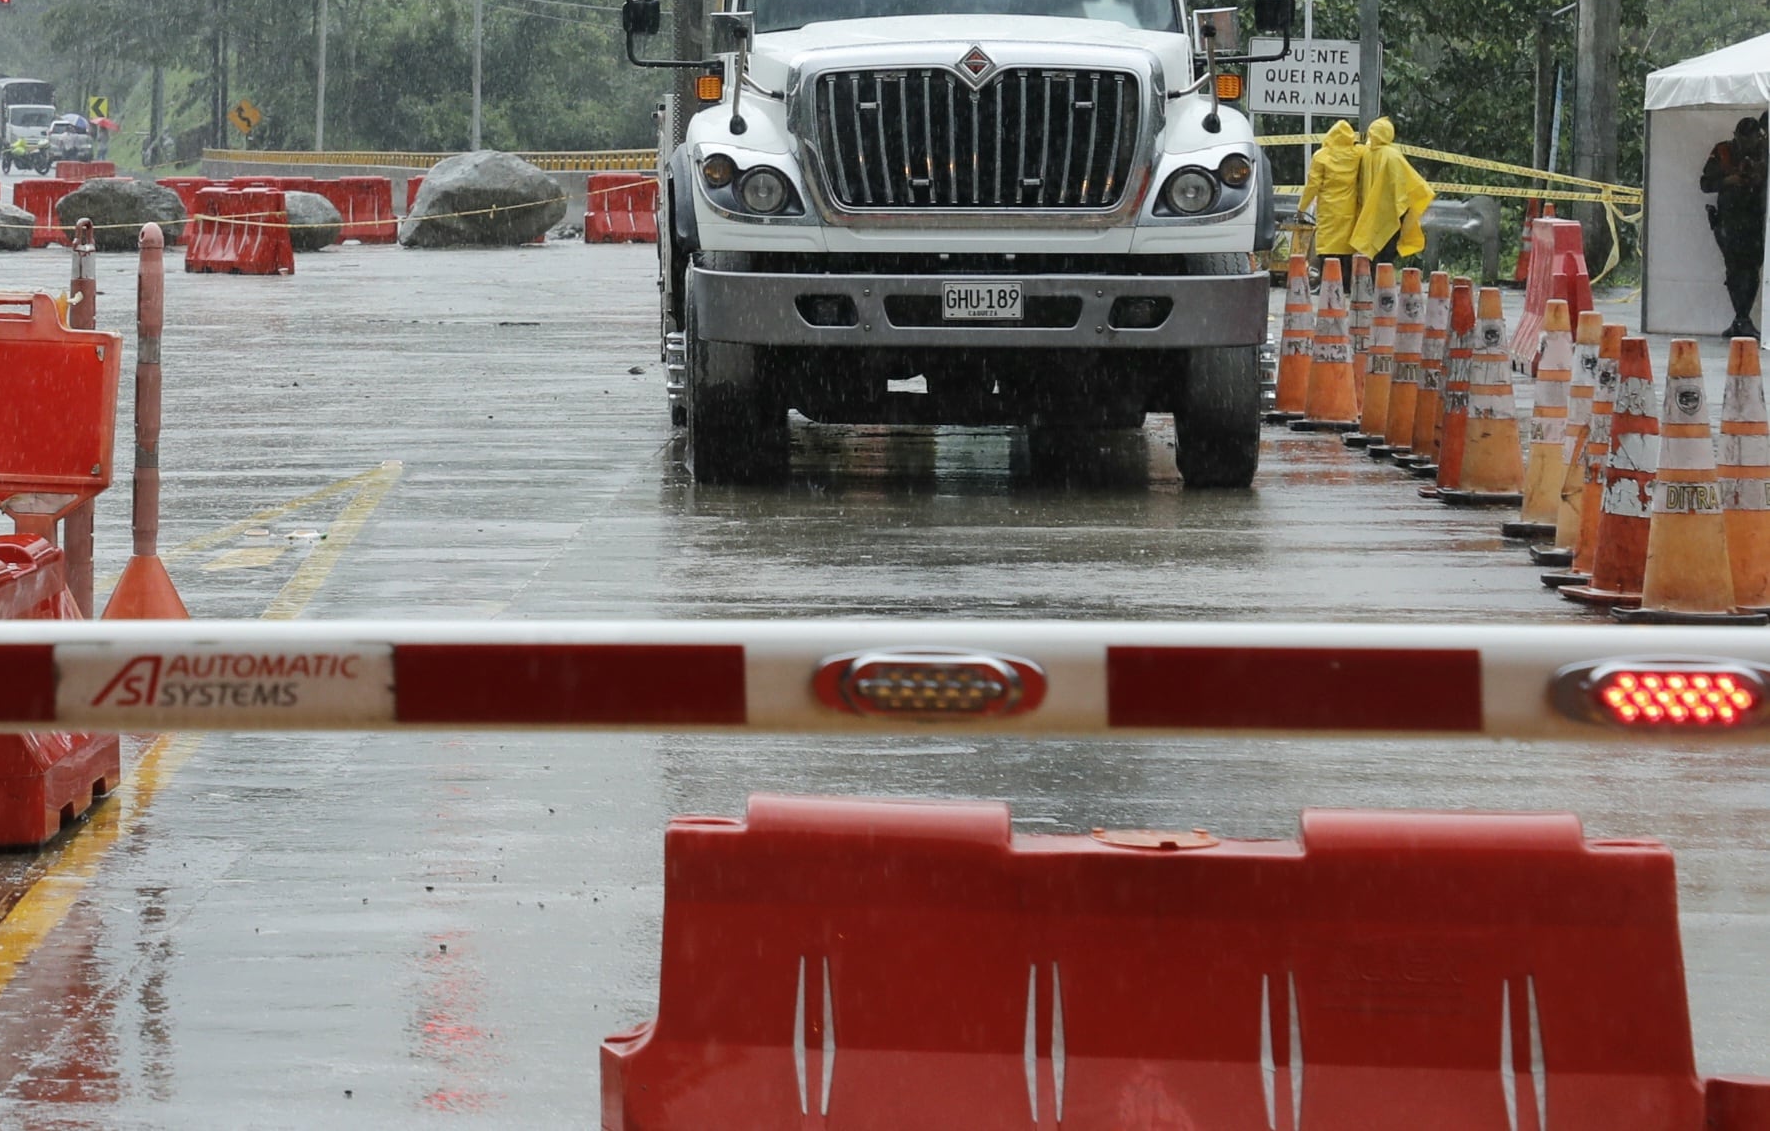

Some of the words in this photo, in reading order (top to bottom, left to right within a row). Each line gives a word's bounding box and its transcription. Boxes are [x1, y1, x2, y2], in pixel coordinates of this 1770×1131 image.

[1265, 68, 1361, 86] QUERADA
[1666, 484, 1719, 510] DITRA
[165, 653, 361, 679] AUTOMATIC
[160, 681, 300, 707] SYSTEMS
